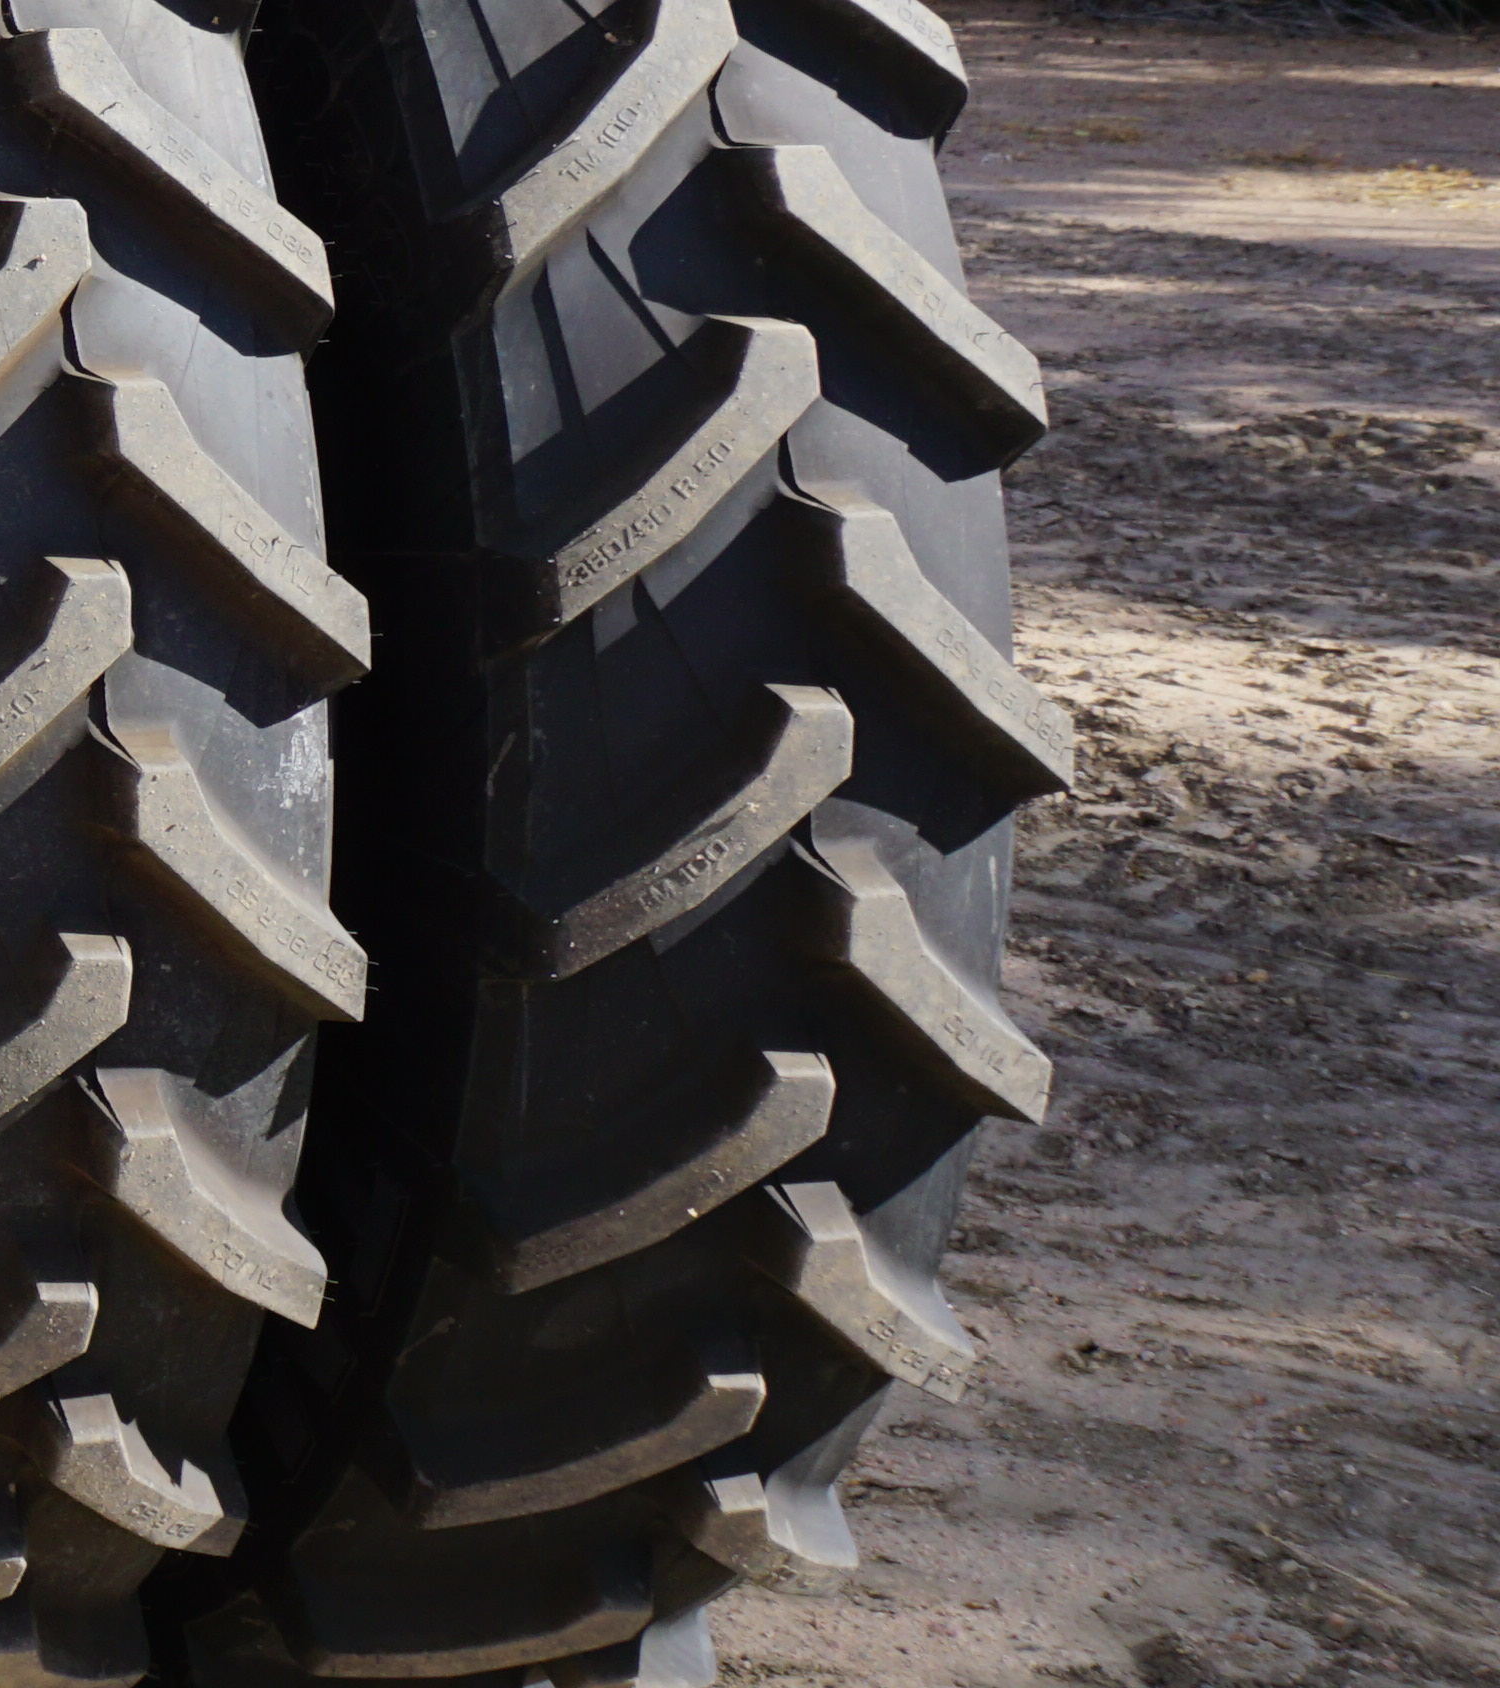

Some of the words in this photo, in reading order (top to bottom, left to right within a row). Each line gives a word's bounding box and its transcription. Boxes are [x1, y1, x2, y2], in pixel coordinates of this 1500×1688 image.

[597, 105, 639, 150] 100
[566, 501, 673, 585] 380/90
[671, 474, 699, 500] R
[694, 438, 734, 477] 50
